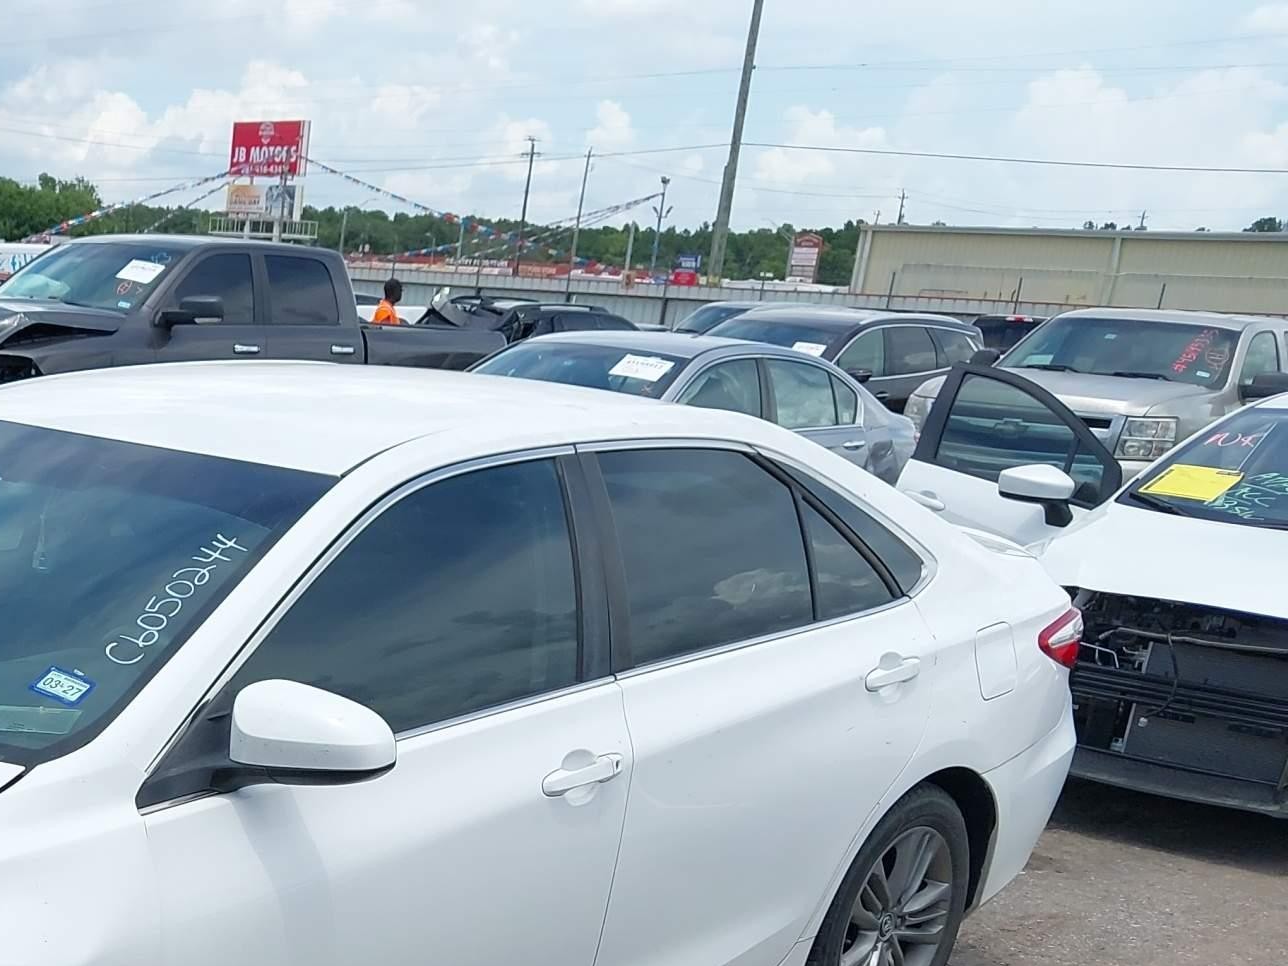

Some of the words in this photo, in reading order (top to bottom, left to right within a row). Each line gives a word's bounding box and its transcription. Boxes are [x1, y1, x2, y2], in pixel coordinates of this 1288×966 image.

[232, 146, 247, 163] JB
[105, 533, 248, 664] C6050244
[42, 677, 61, 689] 03
[62, 685, 83, 697] 27
